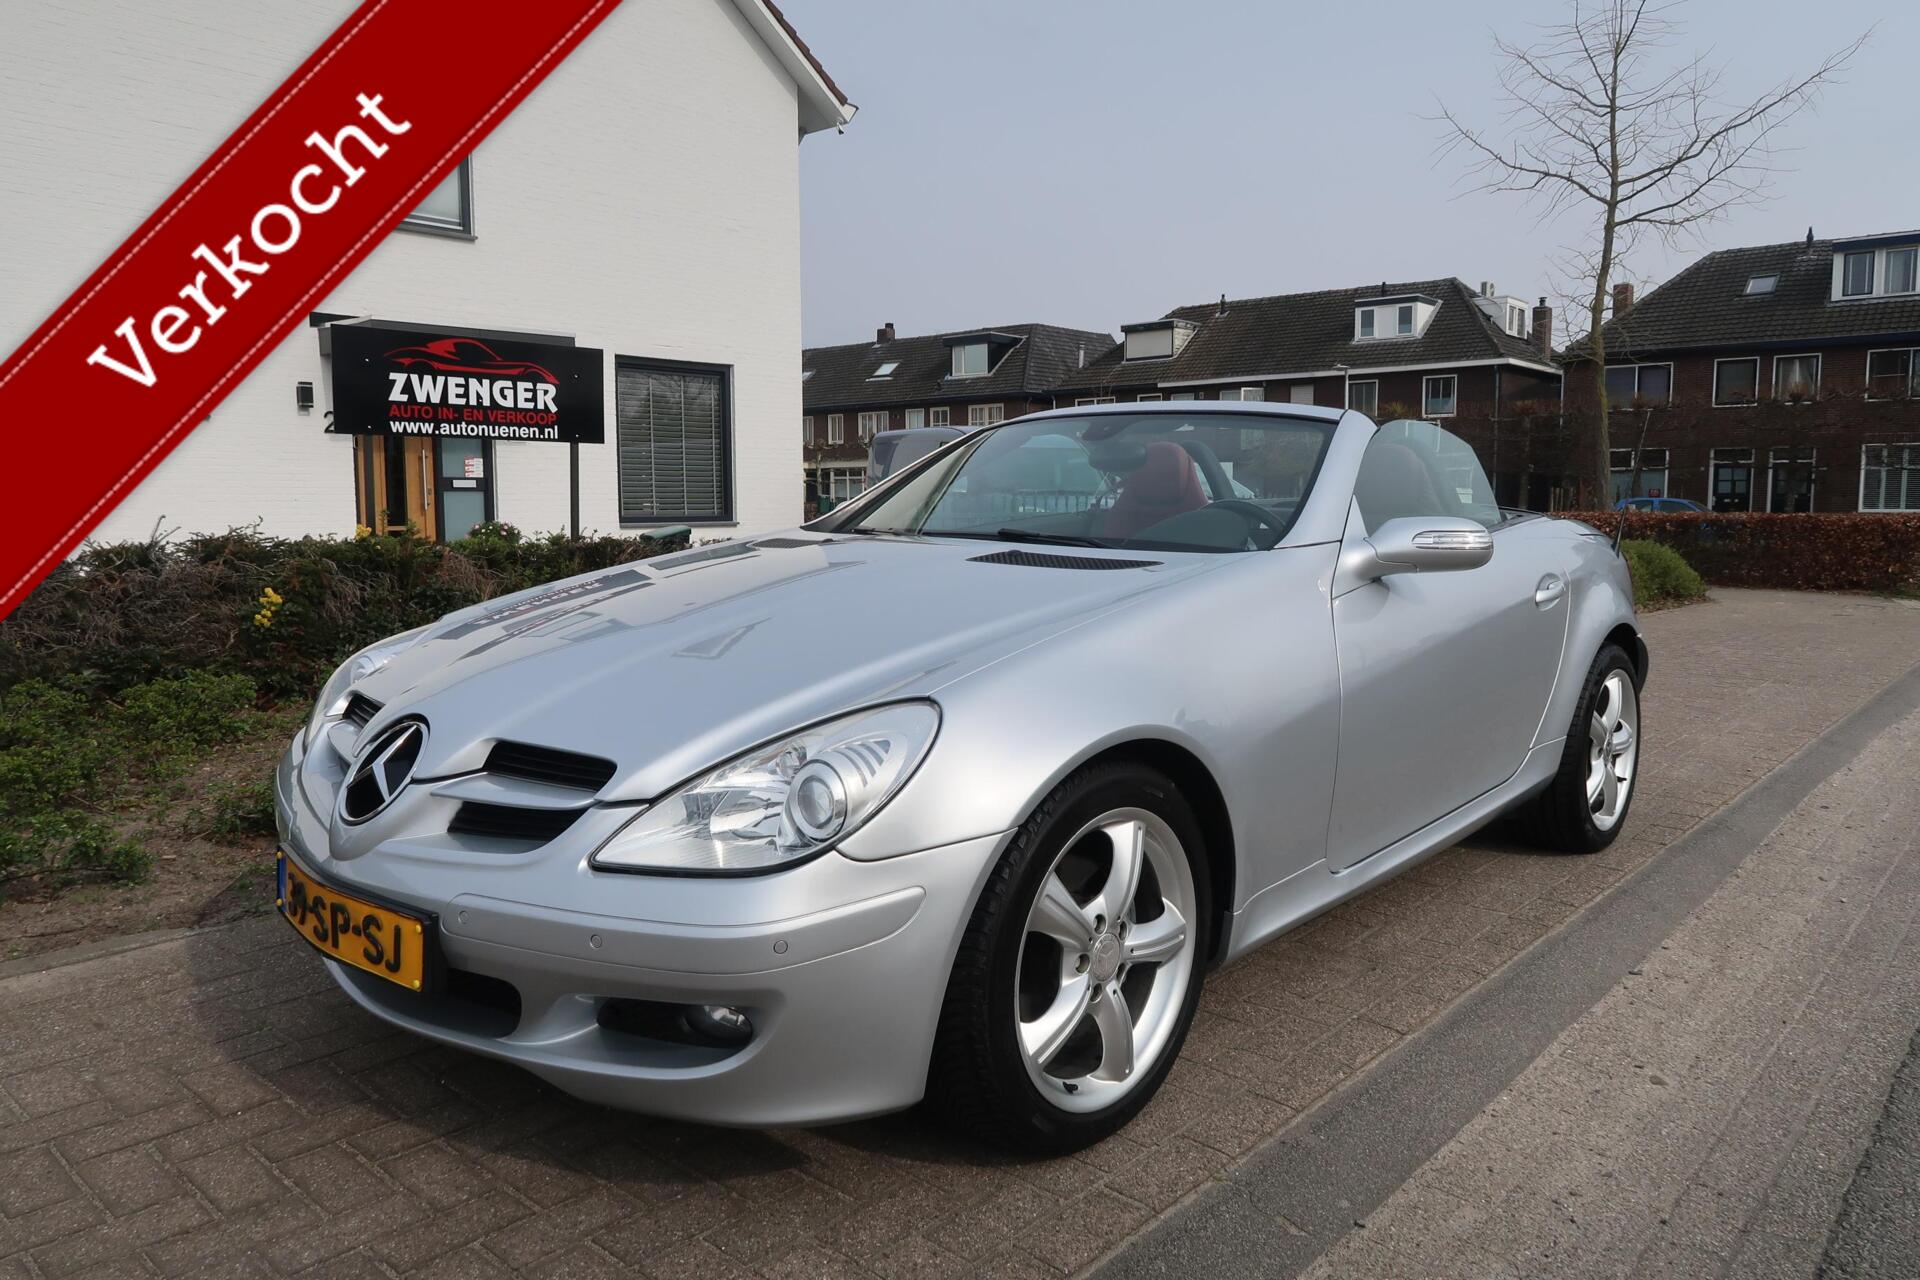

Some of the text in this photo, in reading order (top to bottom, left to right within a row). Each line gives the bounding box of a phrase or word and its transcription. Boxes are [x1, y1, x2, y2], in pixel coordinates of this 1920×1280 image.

[388, 372, 558, 414] ZWENGER
[389, 404, 557, 425] AUTO IN- EN VERKOOP
[389, 420, 559, 440] www.autonuenen.nl
